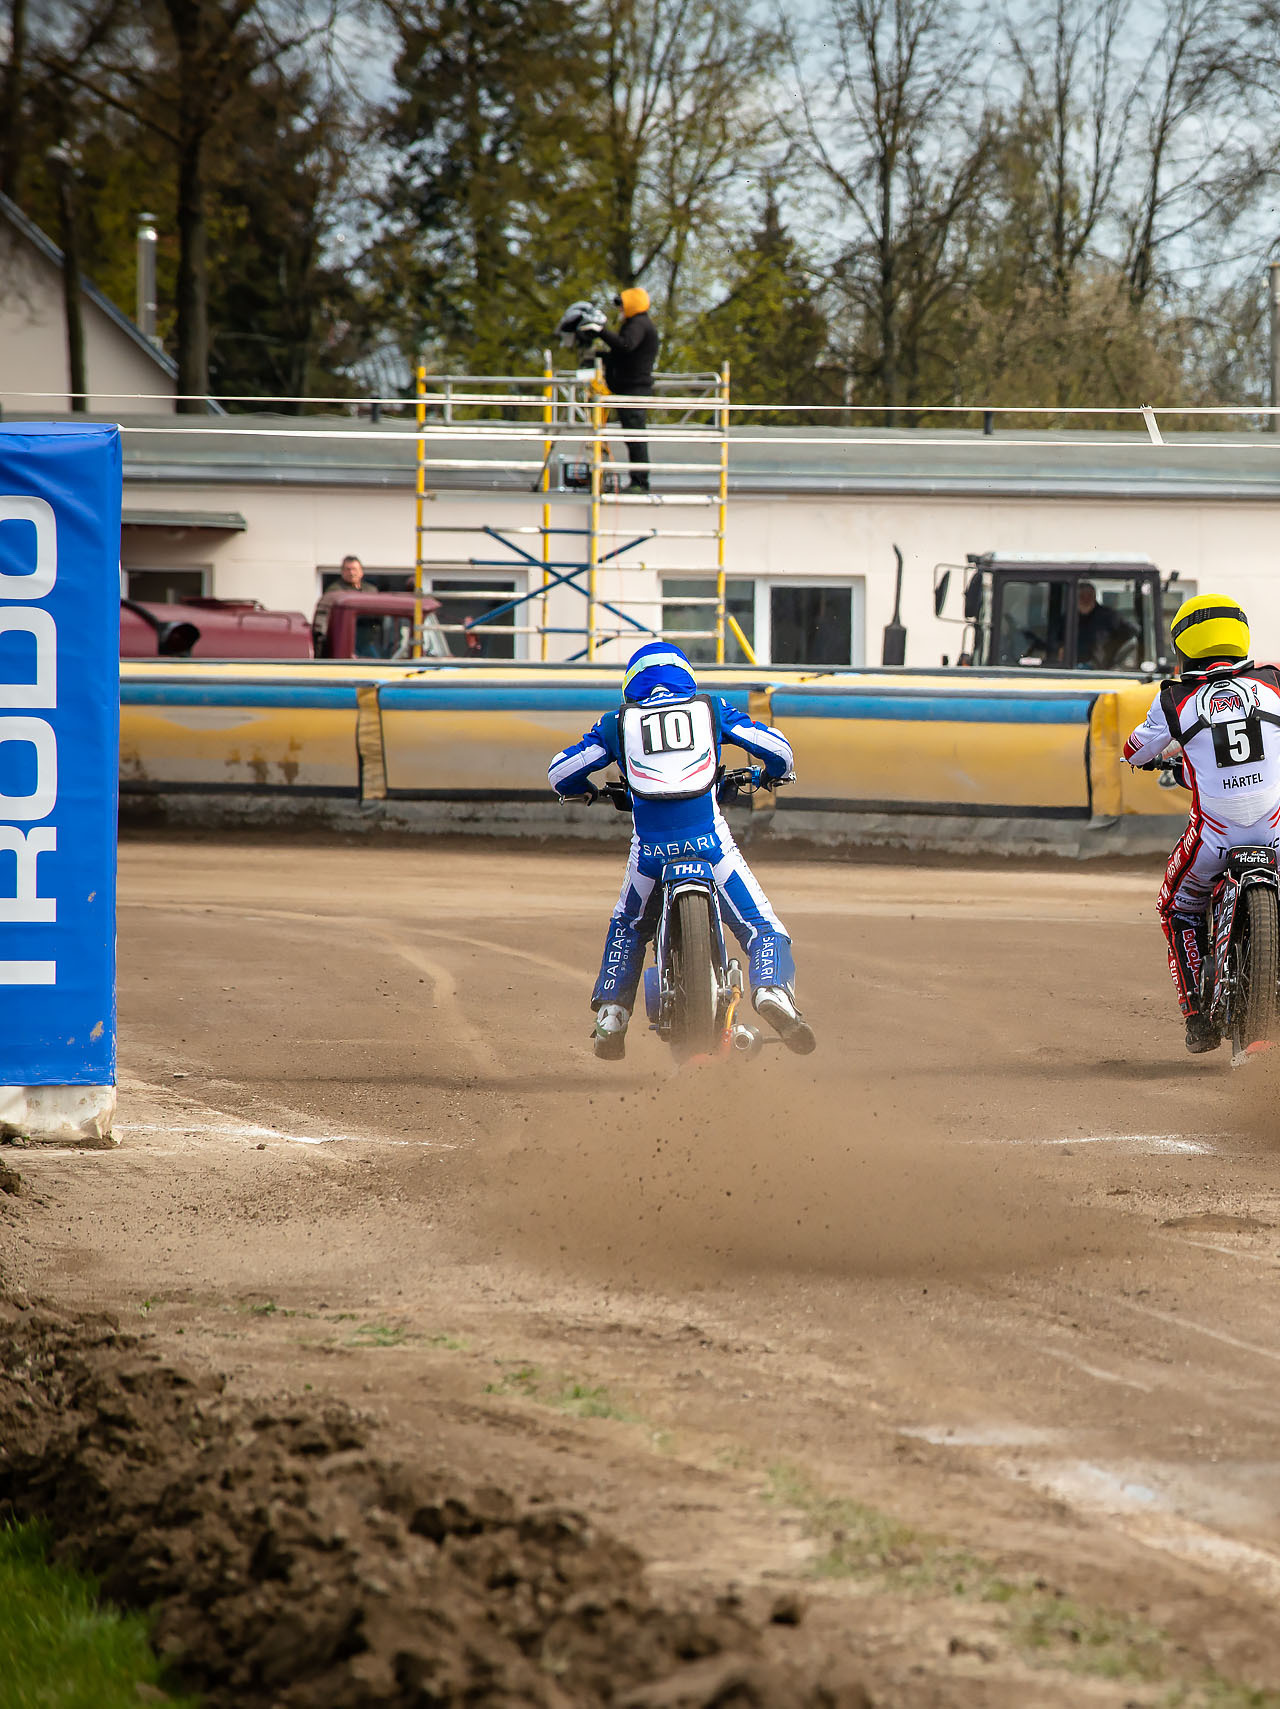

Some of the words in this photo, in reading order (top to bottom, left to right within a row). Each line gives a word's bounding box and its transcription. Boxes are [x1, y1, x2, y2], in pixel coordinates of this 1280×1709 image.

[642, 710, 692, 752] 10
[1226, 721, 1251, 762] 5
[1222, 772, 1263, 790] HÄRTEL
[643, 834, 716, 857] SAGARI
